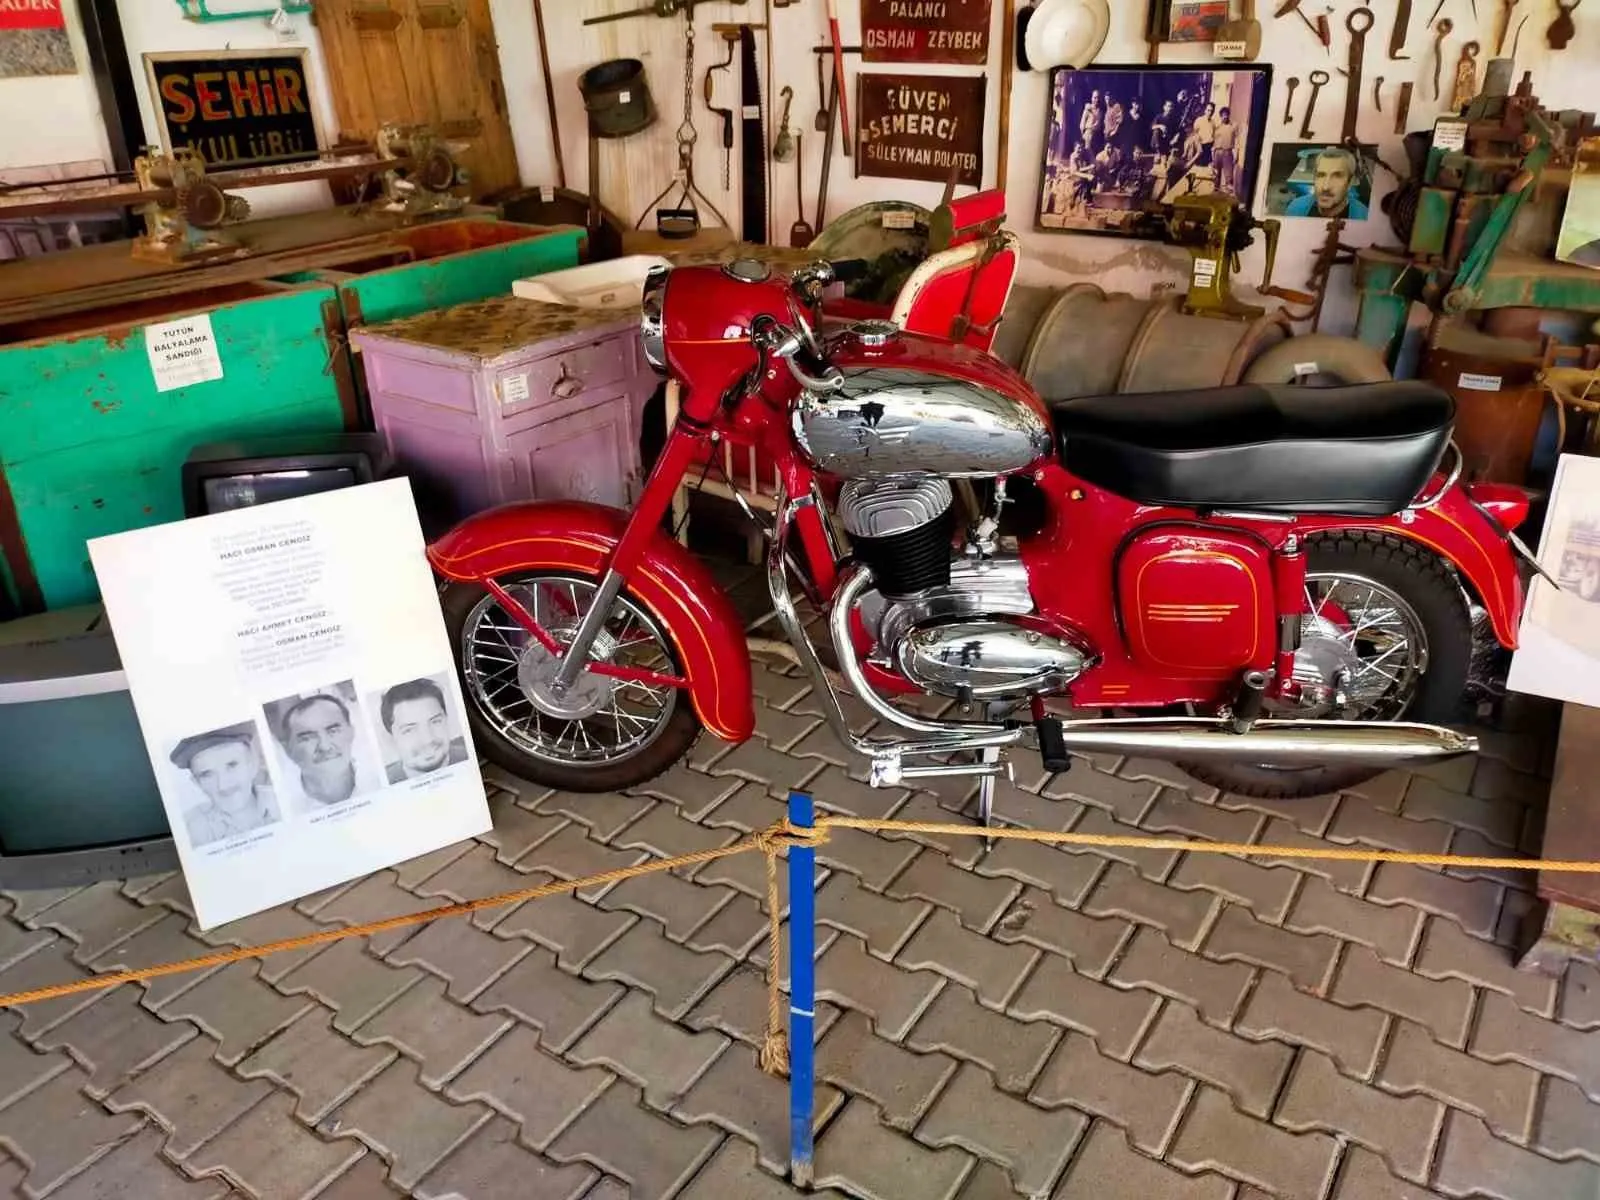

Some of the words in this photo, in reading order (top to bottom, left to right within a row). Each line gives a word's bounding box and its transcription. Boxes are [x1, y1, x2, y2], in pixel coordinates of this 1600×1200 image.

[889, 1, 946, 18] PALANCI
[866, 29, 916, 49] OSMAN
[927, 30, 983, 49] ZEYBEK
[867, 142, 932, 166] SÜLEYMAN
[933, 149, 978, 170] POLATER
[244, 542, 277, 555] OSMAN
